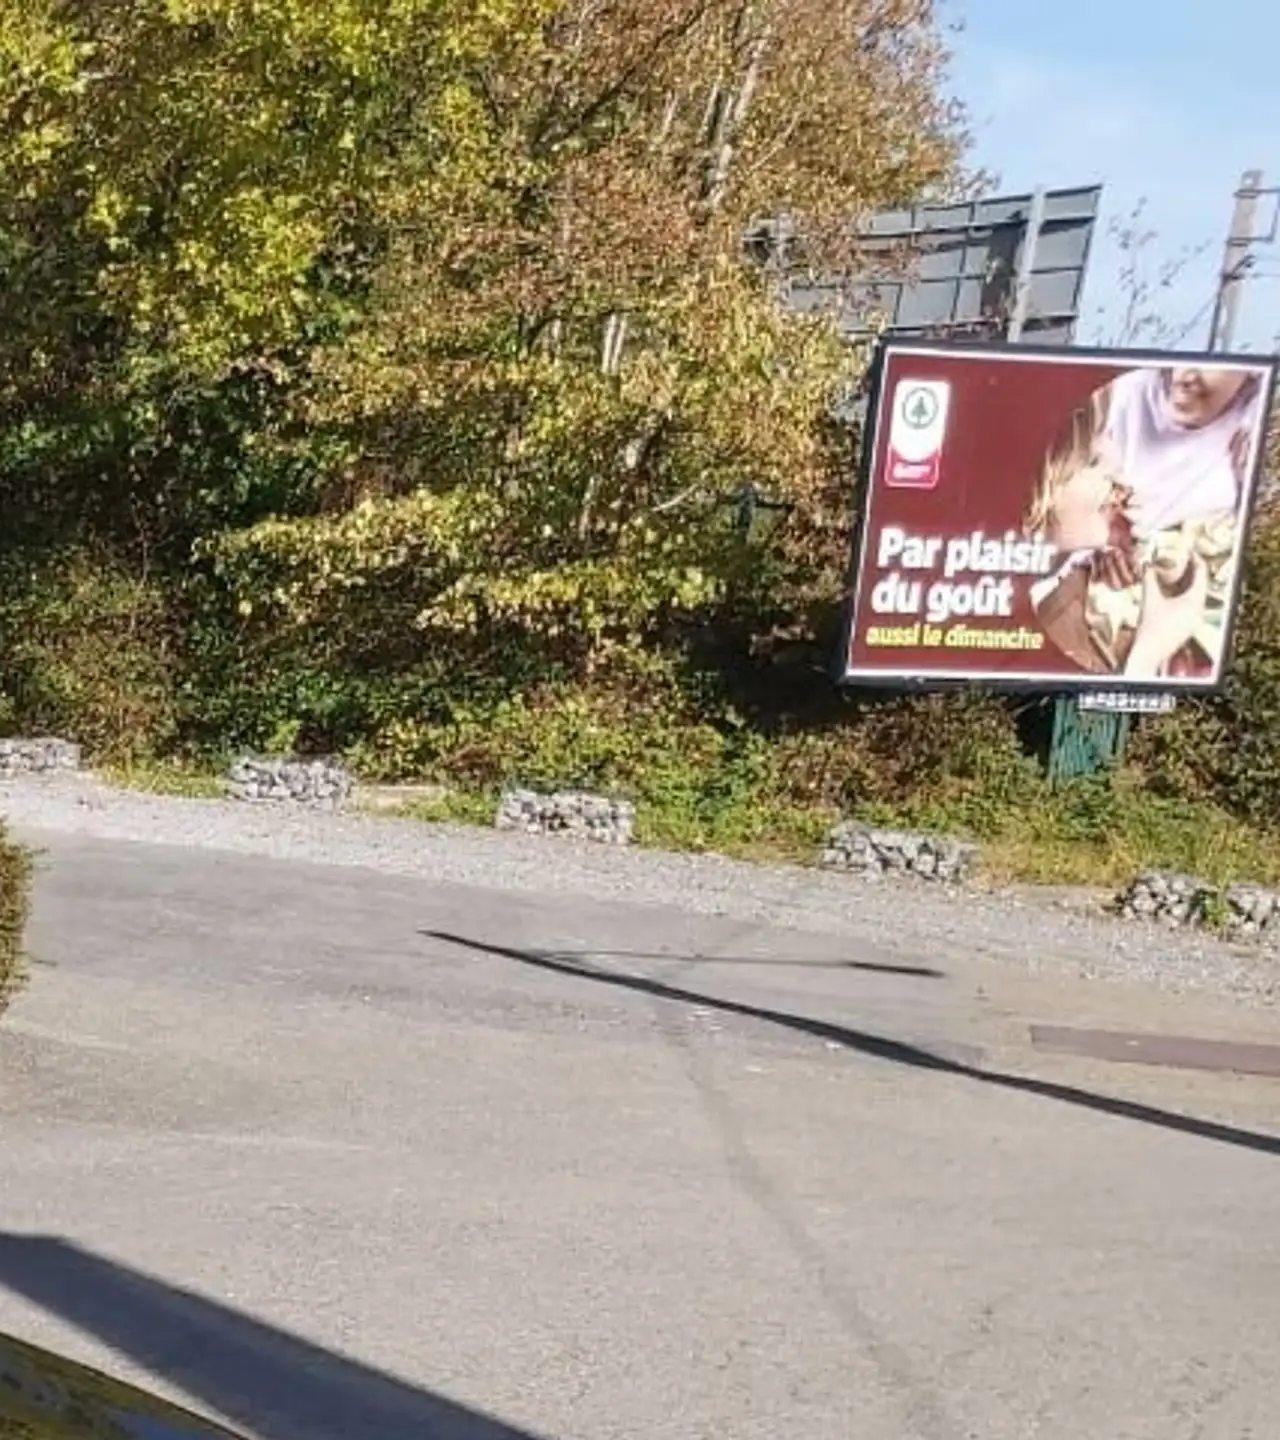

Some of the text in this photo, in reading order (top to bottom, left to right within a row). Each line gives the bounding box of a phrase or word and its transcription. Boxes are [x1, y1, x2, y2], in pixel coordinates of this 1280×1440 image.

[877, 527, 1056, 577] Par plaisir
[871, 572, 1014, 624] du goût
[866, 622, 1044, 650] aussi le dimanche
